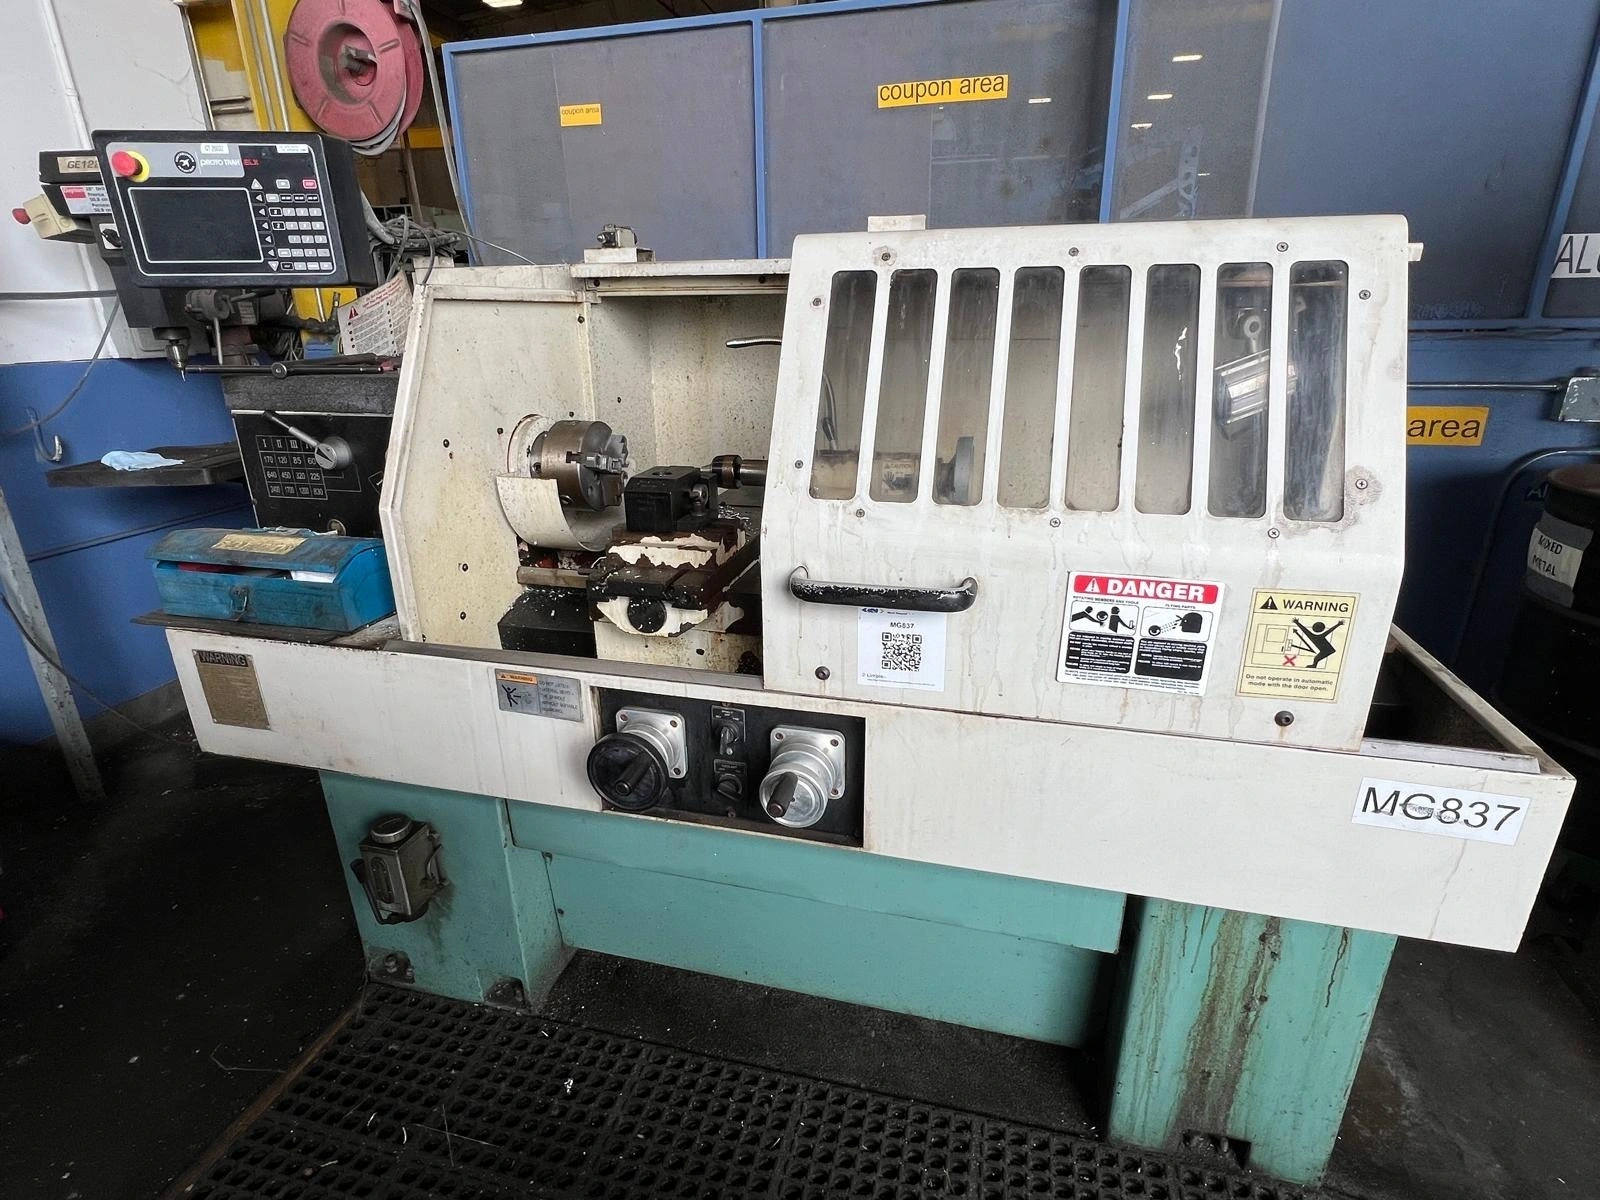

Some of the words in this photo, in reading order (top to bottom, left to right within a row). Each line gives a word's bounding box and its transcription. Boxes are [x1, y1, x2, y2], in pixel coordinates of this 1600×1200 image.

[880, 80, 952, 103] coupon
[960, 76, 1004, 94] area
[1408, 418, 1480, 438] area
[1106, 580, 1205, 601] DANGER
[1282, 600, 1349, 612] WARNING
[200, 651, 246, 666] WARNING
[1362, 786, 1520, 831] MG837
